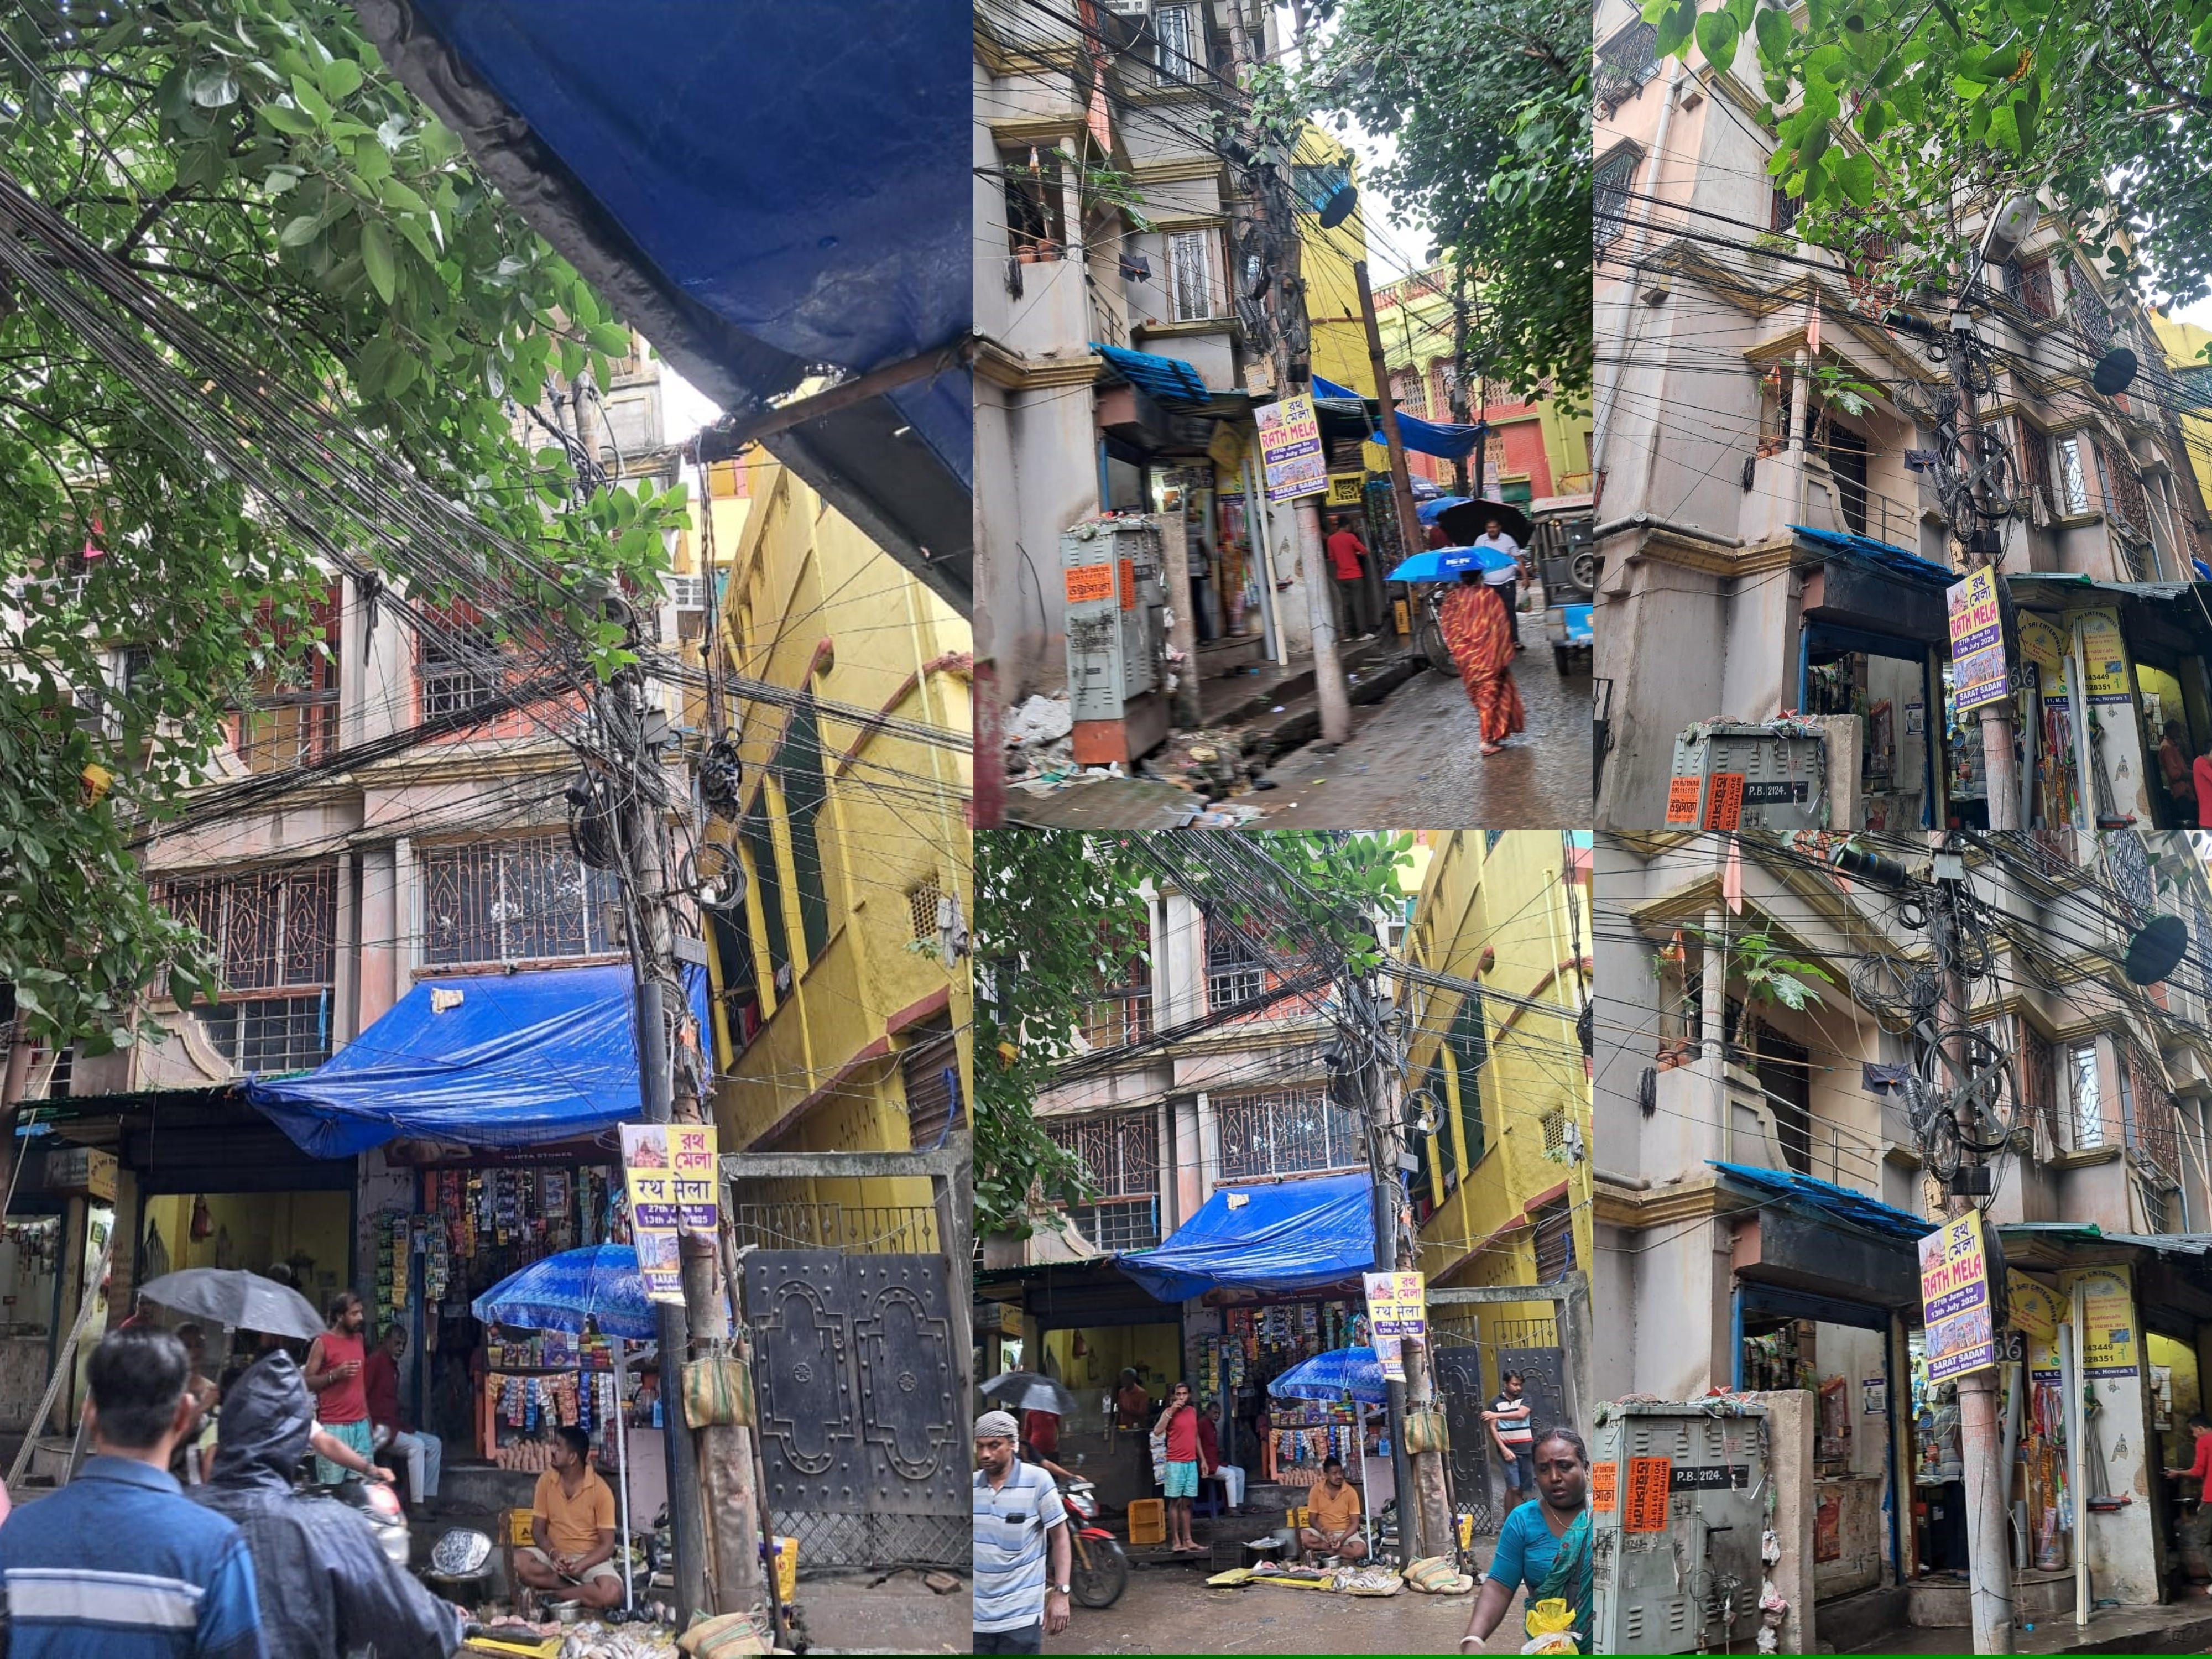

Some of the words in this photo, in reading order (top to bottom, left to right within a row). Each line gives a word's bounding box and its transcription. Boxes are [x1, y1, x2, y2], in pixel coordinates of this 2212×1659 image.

[1287, 399, 1303, 413] রথ
[1285, 409, 1311, 425] মেলা
[1261, 428, 1288, 448] RATH
[1290, 420, 1316, 440] MELA
[1274, 486, 1297, 495] SARAT
[1971, 572, 1985, 591] রথ
[1970, 585, 1991, 607] মেলা
[1950, 612, 1972, 638] RATH
[1974, 601, 1996, 628] MELA
[2084, 611, 2118, 629] ENTERPRISE
[1957, 645, 1968, 655] 13th
[1969, 640, 1980, 653] July
[1981, 635, 1994, 646] 2025
[1959, 638, 1970, 646] 27th
[1971, 632, 1984, 643] June
[2039, 622, 2062, 657] ENTERPRISE
[1960, 688, 1978, 701] SARAT
[1980, 681, 2001, 693] SADAN
[1749, 786, 1765, 796] P.B.
[680, 1132, 704, 1150] রথ
[675, 1151, 712, 1170] মেলা
[636, 1179, 665, 1200] रथ
[672, 1172, 711, 1200] मेला
[1952, 1220, 1969, 1241] রথ
[1949, 1235, 1975, 1261] মেলা
[1401, 1276, 1416, 1288] রথ
[1923, 1267, 1950, 1298] RATH
[1952, 1253, 1982, 1285] MELA
[1397, 1288, 1421, 1300] মেলা
[1933, 1297, 1947, 1308] 27th
[1949, 1291, 1965, 1304] June
[1966, 1287, 1974, 1295] to
[1374, 1306, 1391, 1318] रथ
[1395, 1301, 1420, 1318] मेला
[1931, 1308, 1945, 1319] 13th
[1946, 1302, 1960, 1314] July
[1961, 1294, 1978, 1306] 2025
[1933, 1357, 1957, 1371] SARAT
[1959, 1347, 1985, 1363] SADAN
[1677, 1472, 1697, 1481] P.B.
[1649, 1462, 1661, 1528] 9051191917
